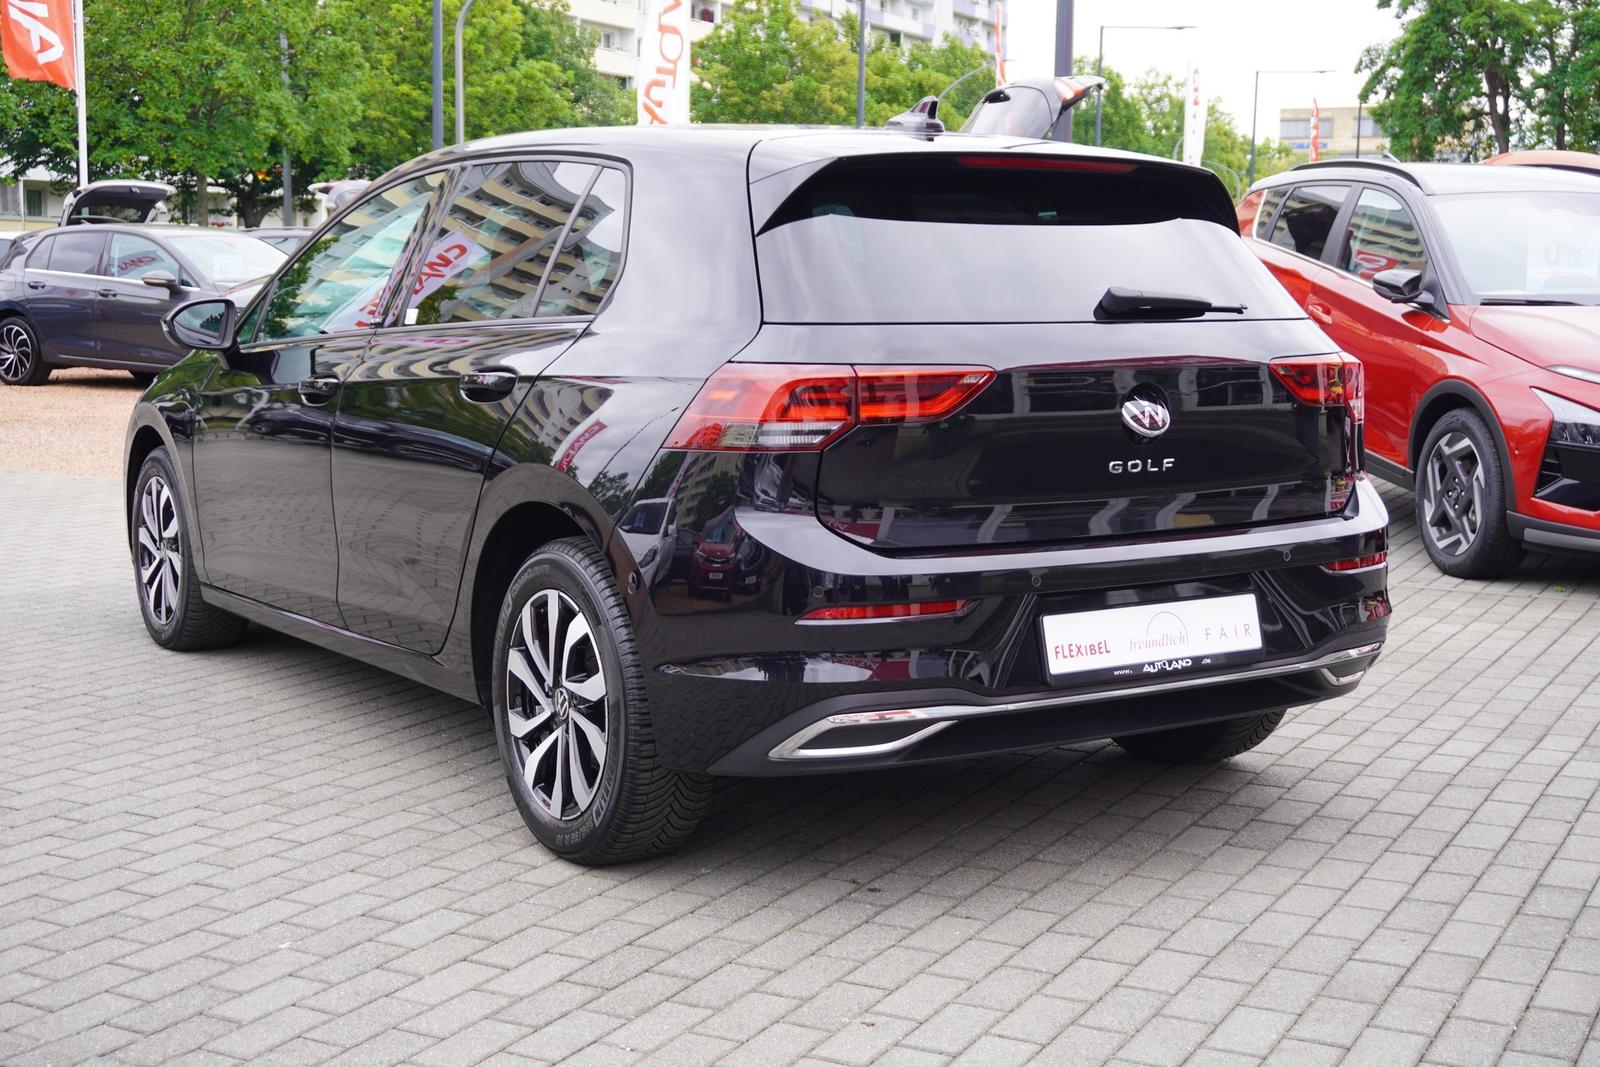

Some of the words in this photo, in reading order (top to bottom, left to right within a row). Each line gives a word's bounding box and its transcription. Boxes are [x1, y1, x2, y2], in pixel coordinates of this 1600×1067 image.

[1108, 458, 1175, 474] GOLF
[1054, 639, 1111, 660] FLEXIBEL
[1129, 631, 1187, 655] freundlich
[1204, 622, 1252, 642] FAIR
[1142, 658, 1193, 673] AUTOLAND
